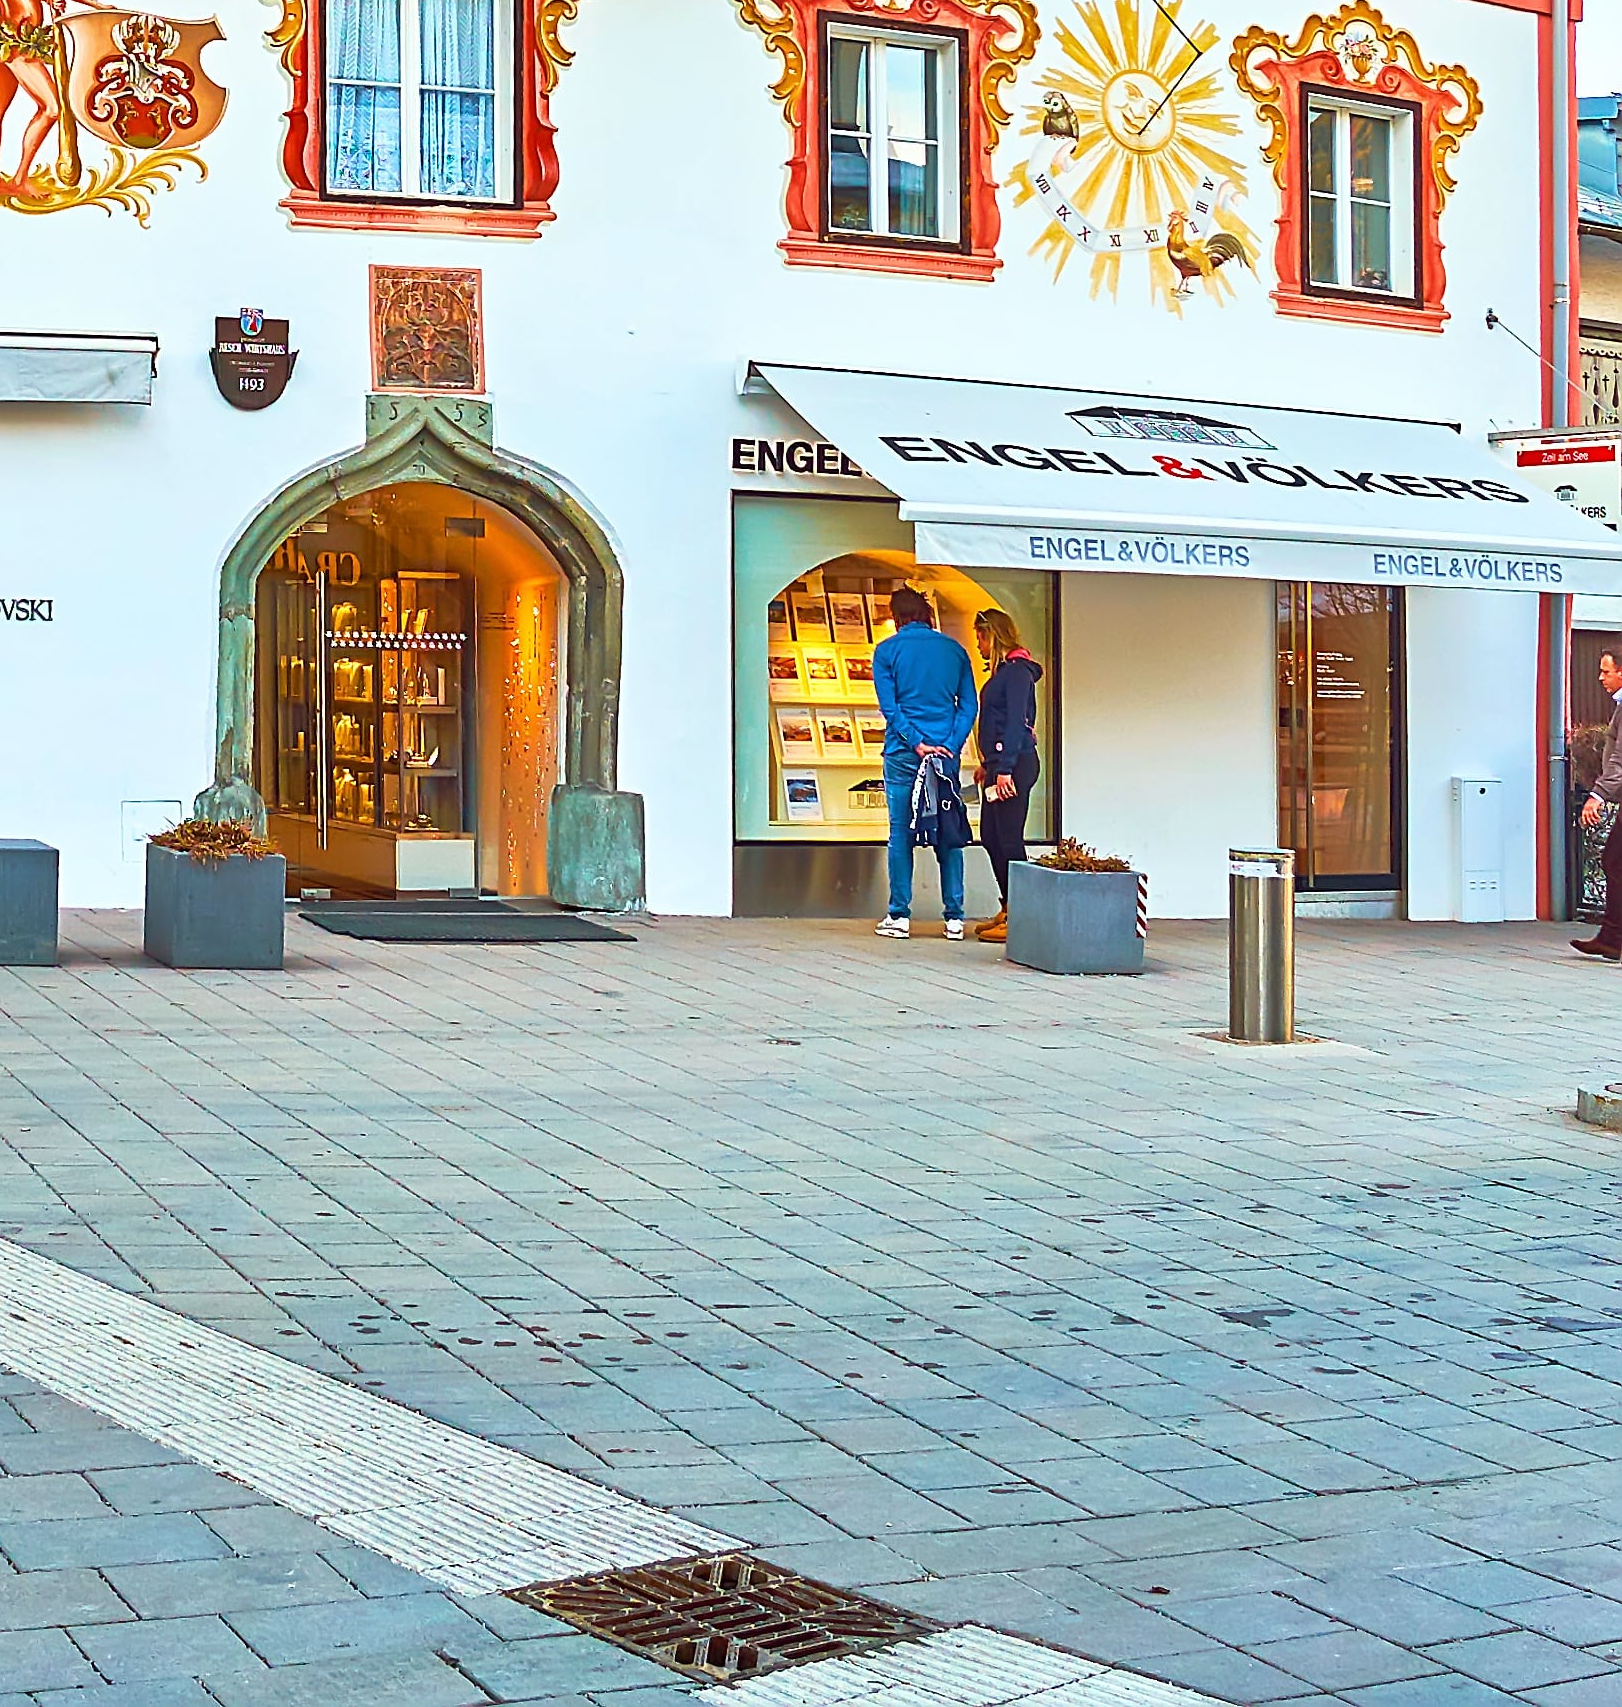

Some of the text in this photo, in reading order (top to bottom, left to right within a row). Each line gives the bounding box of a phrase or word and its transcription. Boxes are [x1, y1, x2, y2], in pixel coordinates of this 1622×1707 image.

[1035, 173, 1051, 195] VIII
[1077, 226, 1091, 242] X
[1109, 234, 1122, 247] XI
[1143, 229, 1159, 243] XII
[732, 438, 872, 478] ENGEL
[1572, 450, 1589, 461] See
[878, 436, 1529, 503] ENGEL&VÖLKERS
[1029, 536, 1250, 567] ENGEL&VÖLKERS
[1373, 553, 1563, 583] ENGEL&VÖLKERS
